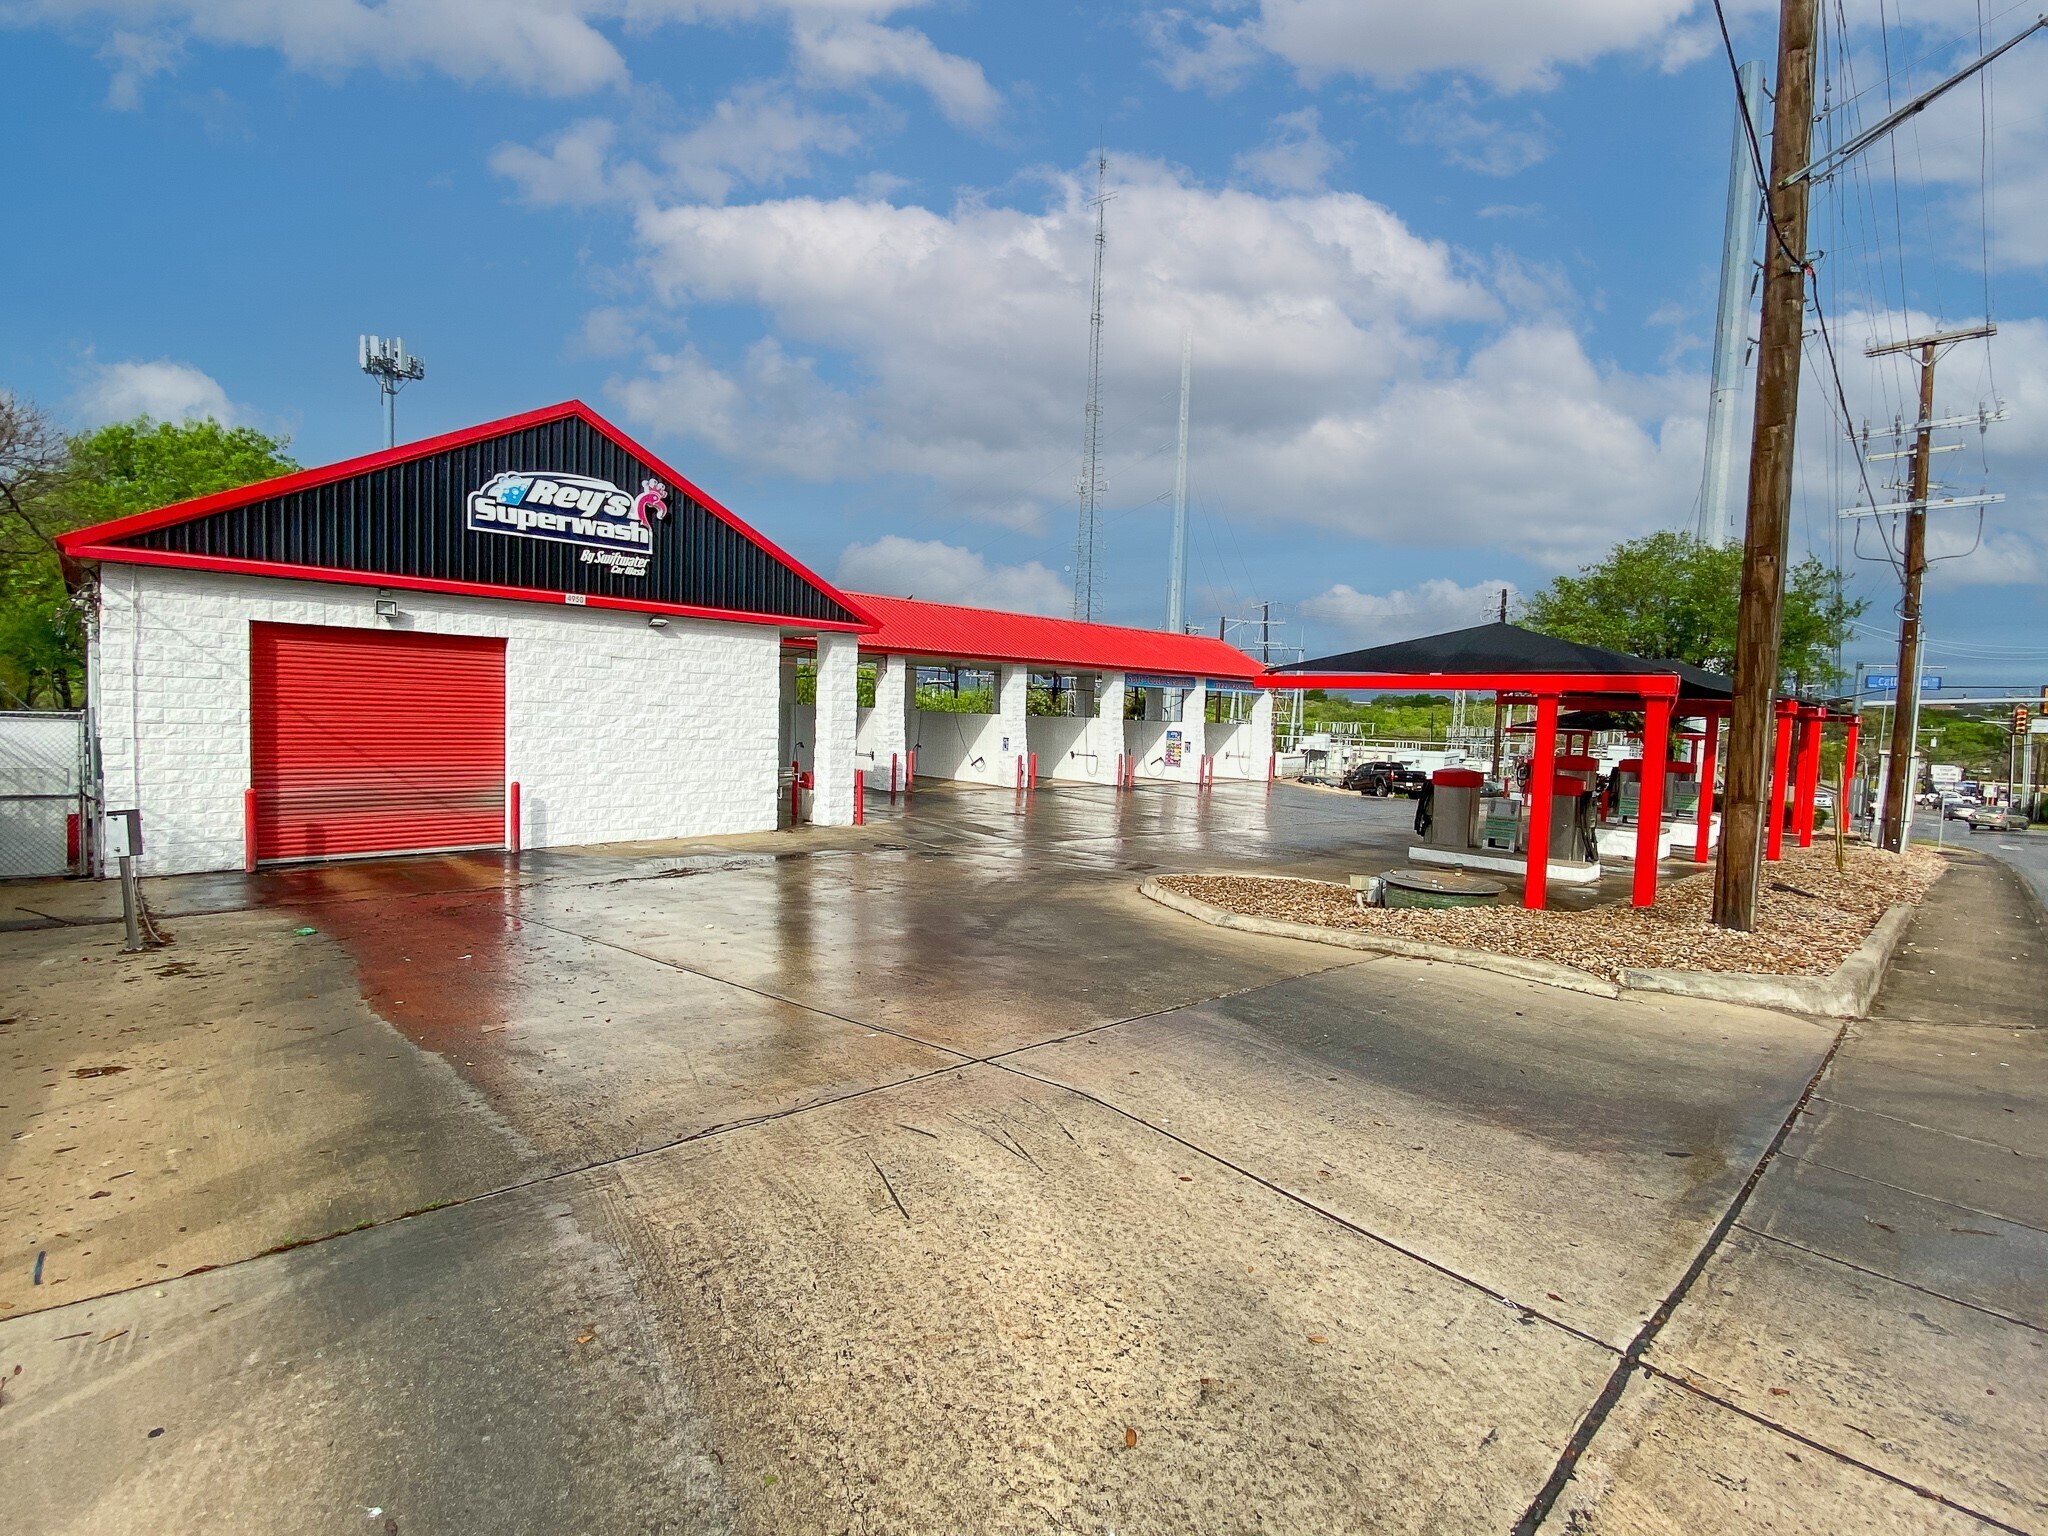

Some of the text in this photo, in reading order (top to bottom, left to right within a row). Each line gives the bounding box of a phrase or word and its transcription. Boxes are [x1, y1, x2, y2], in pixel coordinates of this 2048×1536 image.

[526, 480, 631, 518] Rey's
[475, 497, 649, 544] Superwash
[580, 549, 650, 568] By Swiftwater
[610, 565, 646, 576] Car Wash
[567, 594, 584, 604] 4950
